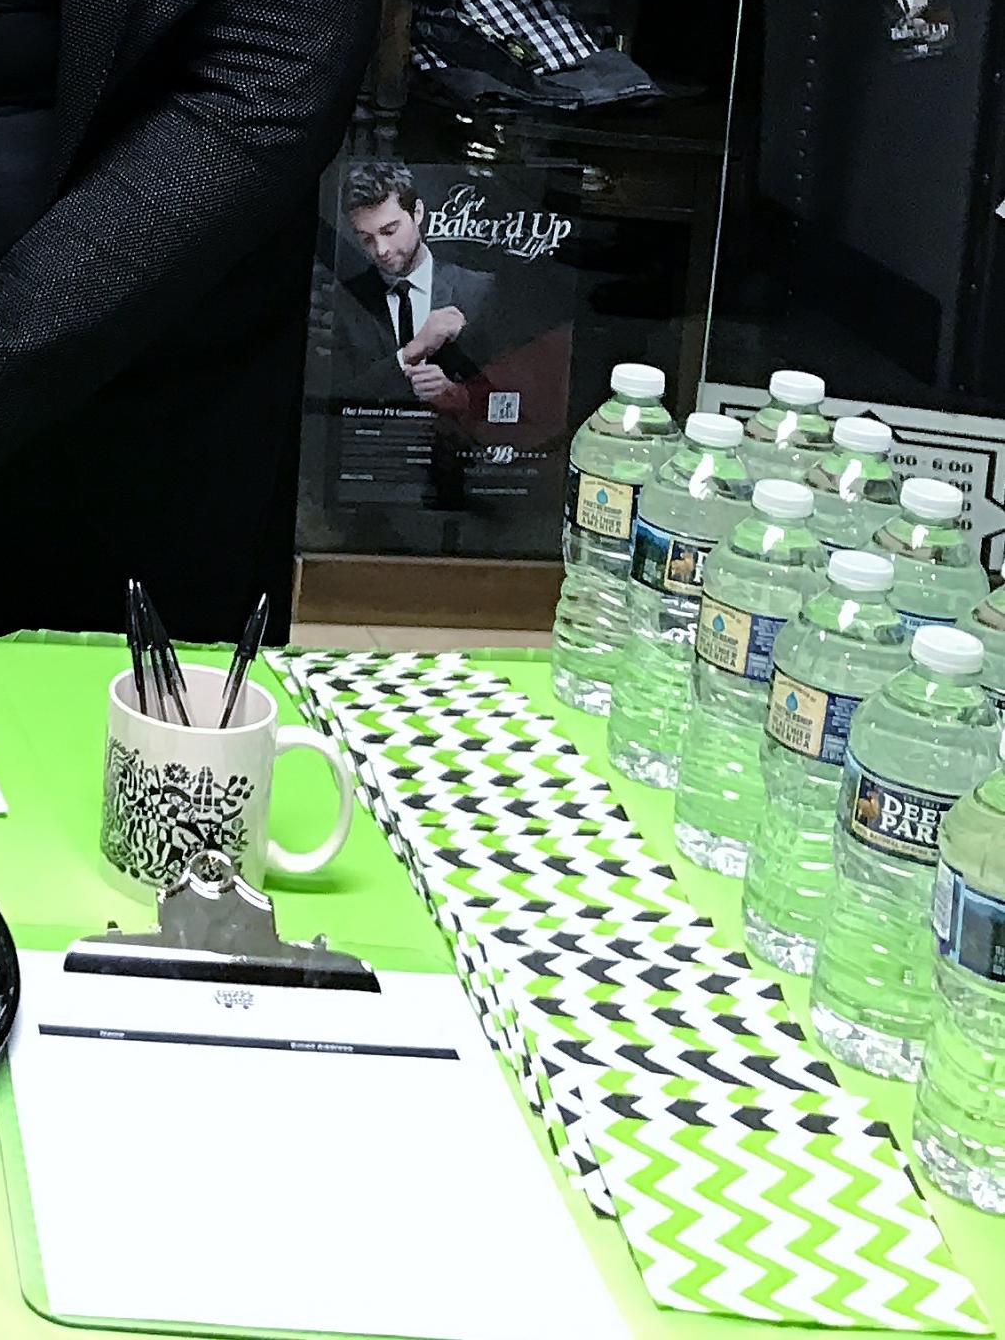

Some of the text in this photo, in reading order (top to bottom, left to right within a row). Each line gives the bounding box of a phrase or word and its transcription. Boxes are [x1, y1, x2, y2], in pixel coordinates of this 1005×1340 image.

[532, 211, 572, 248] Up
[881, 792, 941, 826] DEE
[879, 811, 935, 844] PAR
